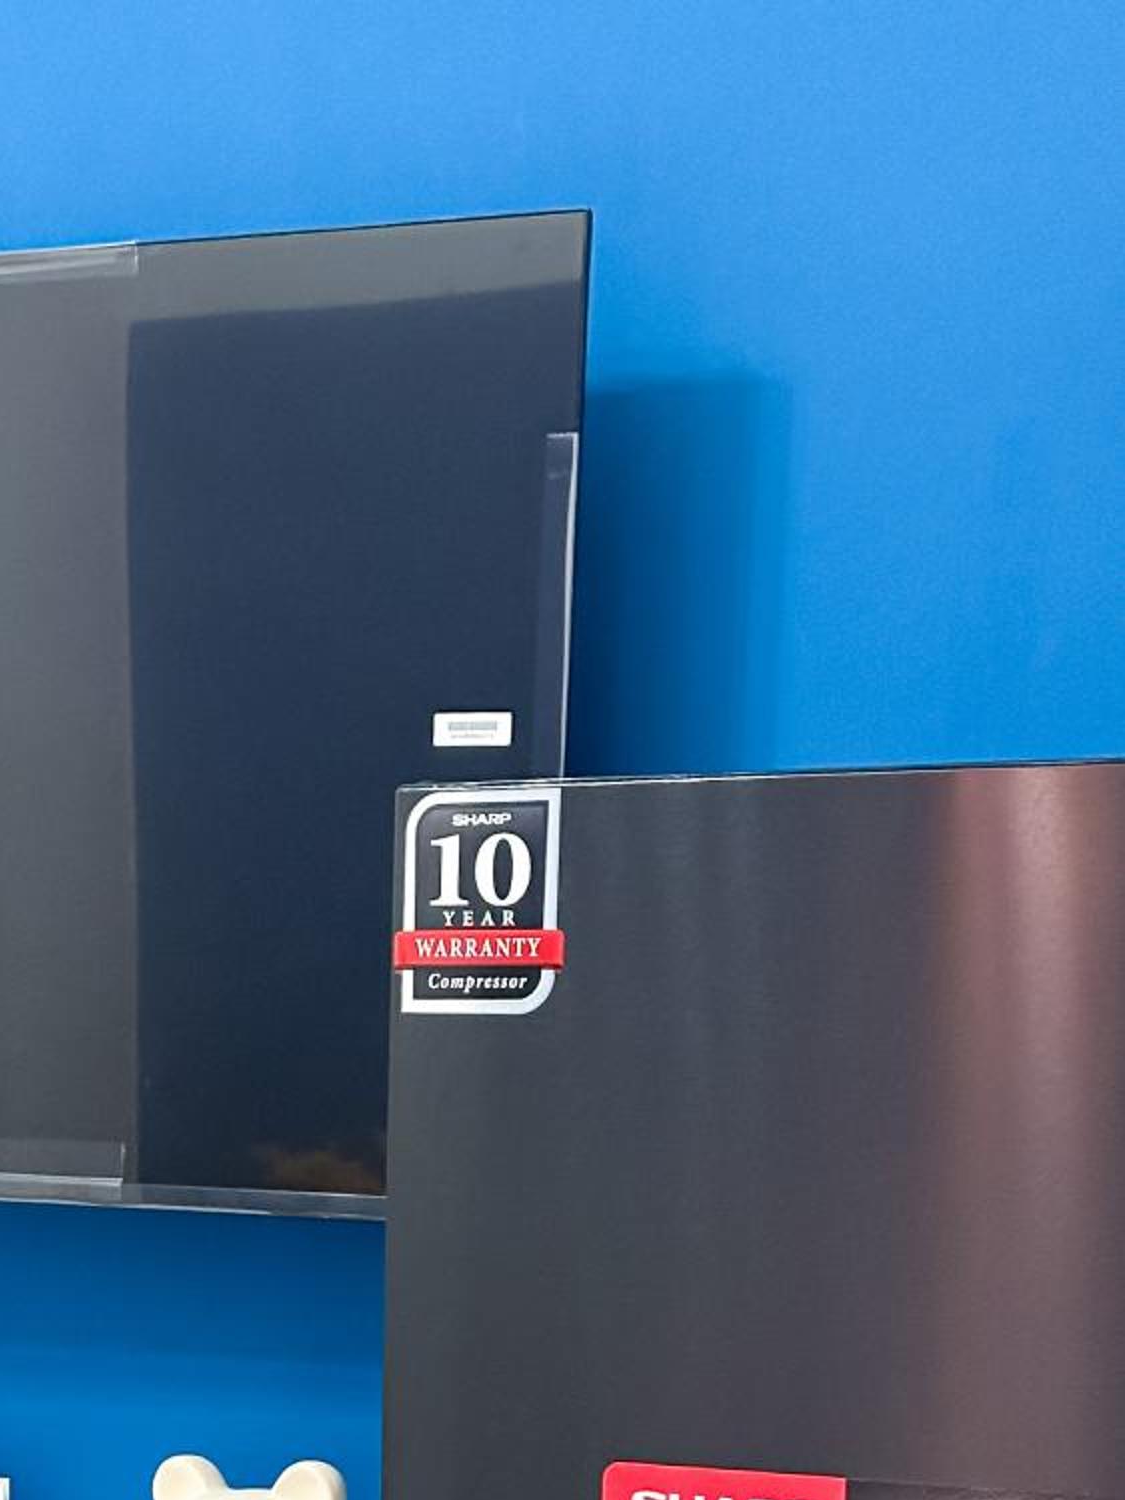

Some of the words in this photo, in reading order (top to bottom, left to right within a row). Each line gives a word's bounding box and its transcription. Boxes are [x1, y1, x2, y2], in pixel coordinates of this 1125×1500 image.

[452, 813, 512, 827] SHARP
[429, 832, 532, 907] 10
[442, 909, 516, 927] YEAR
[415, 937, 542, 958] WARRANTY
[428, 973, 529, 993] Compressor
